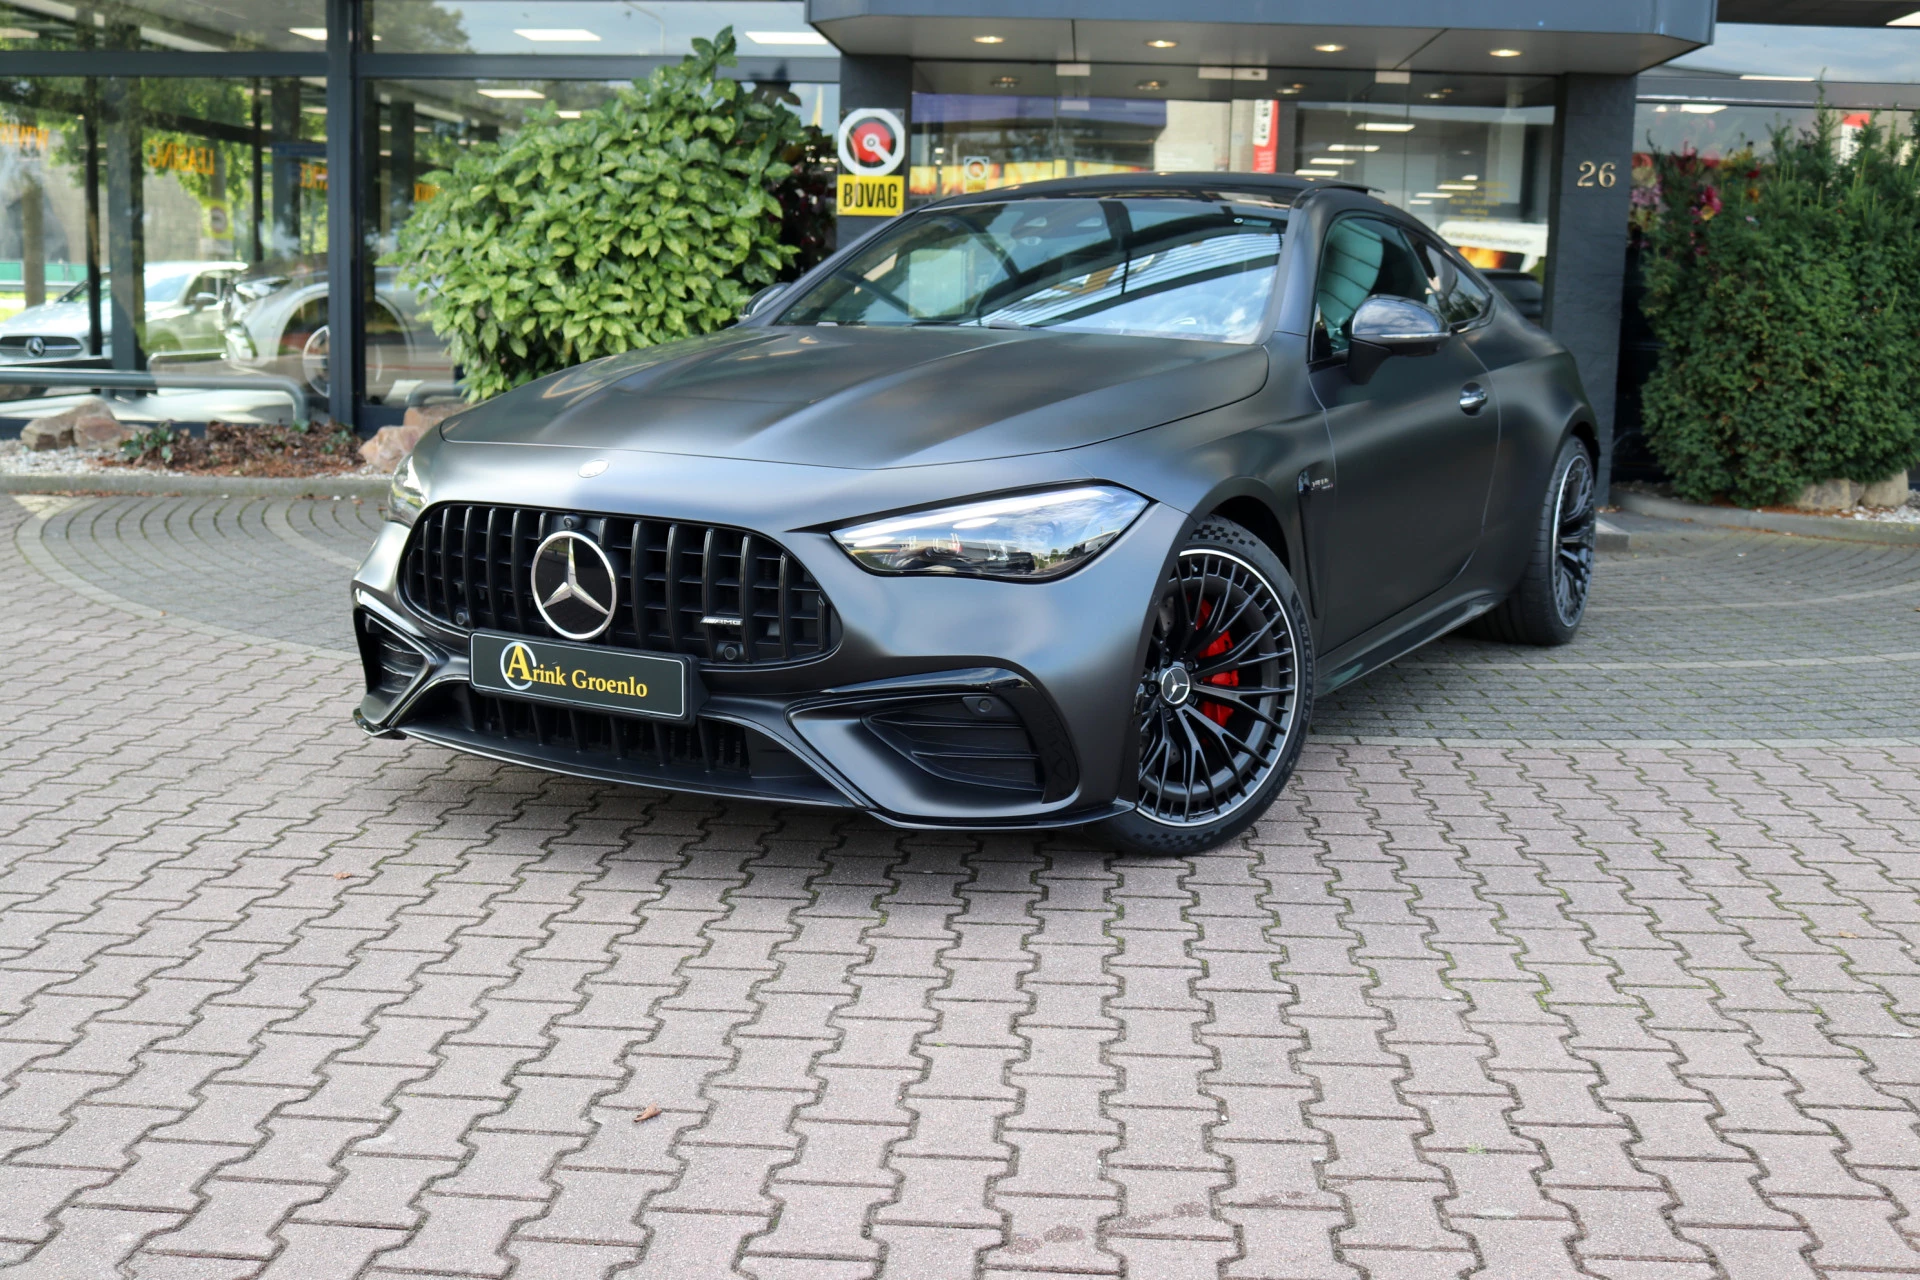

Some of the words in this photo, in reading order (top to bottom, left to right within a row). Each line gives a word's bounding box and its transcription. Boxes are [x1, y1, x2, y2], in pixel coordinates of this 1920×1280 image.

[1577, 161, 1616, 188] 26
[843, 183, 898, 209] BOVAG
[505, 644, 567, 686] Arink
[571, 669, 648, 698] Groenlo
[1300, 623, 1314, 722] MICHELIN
